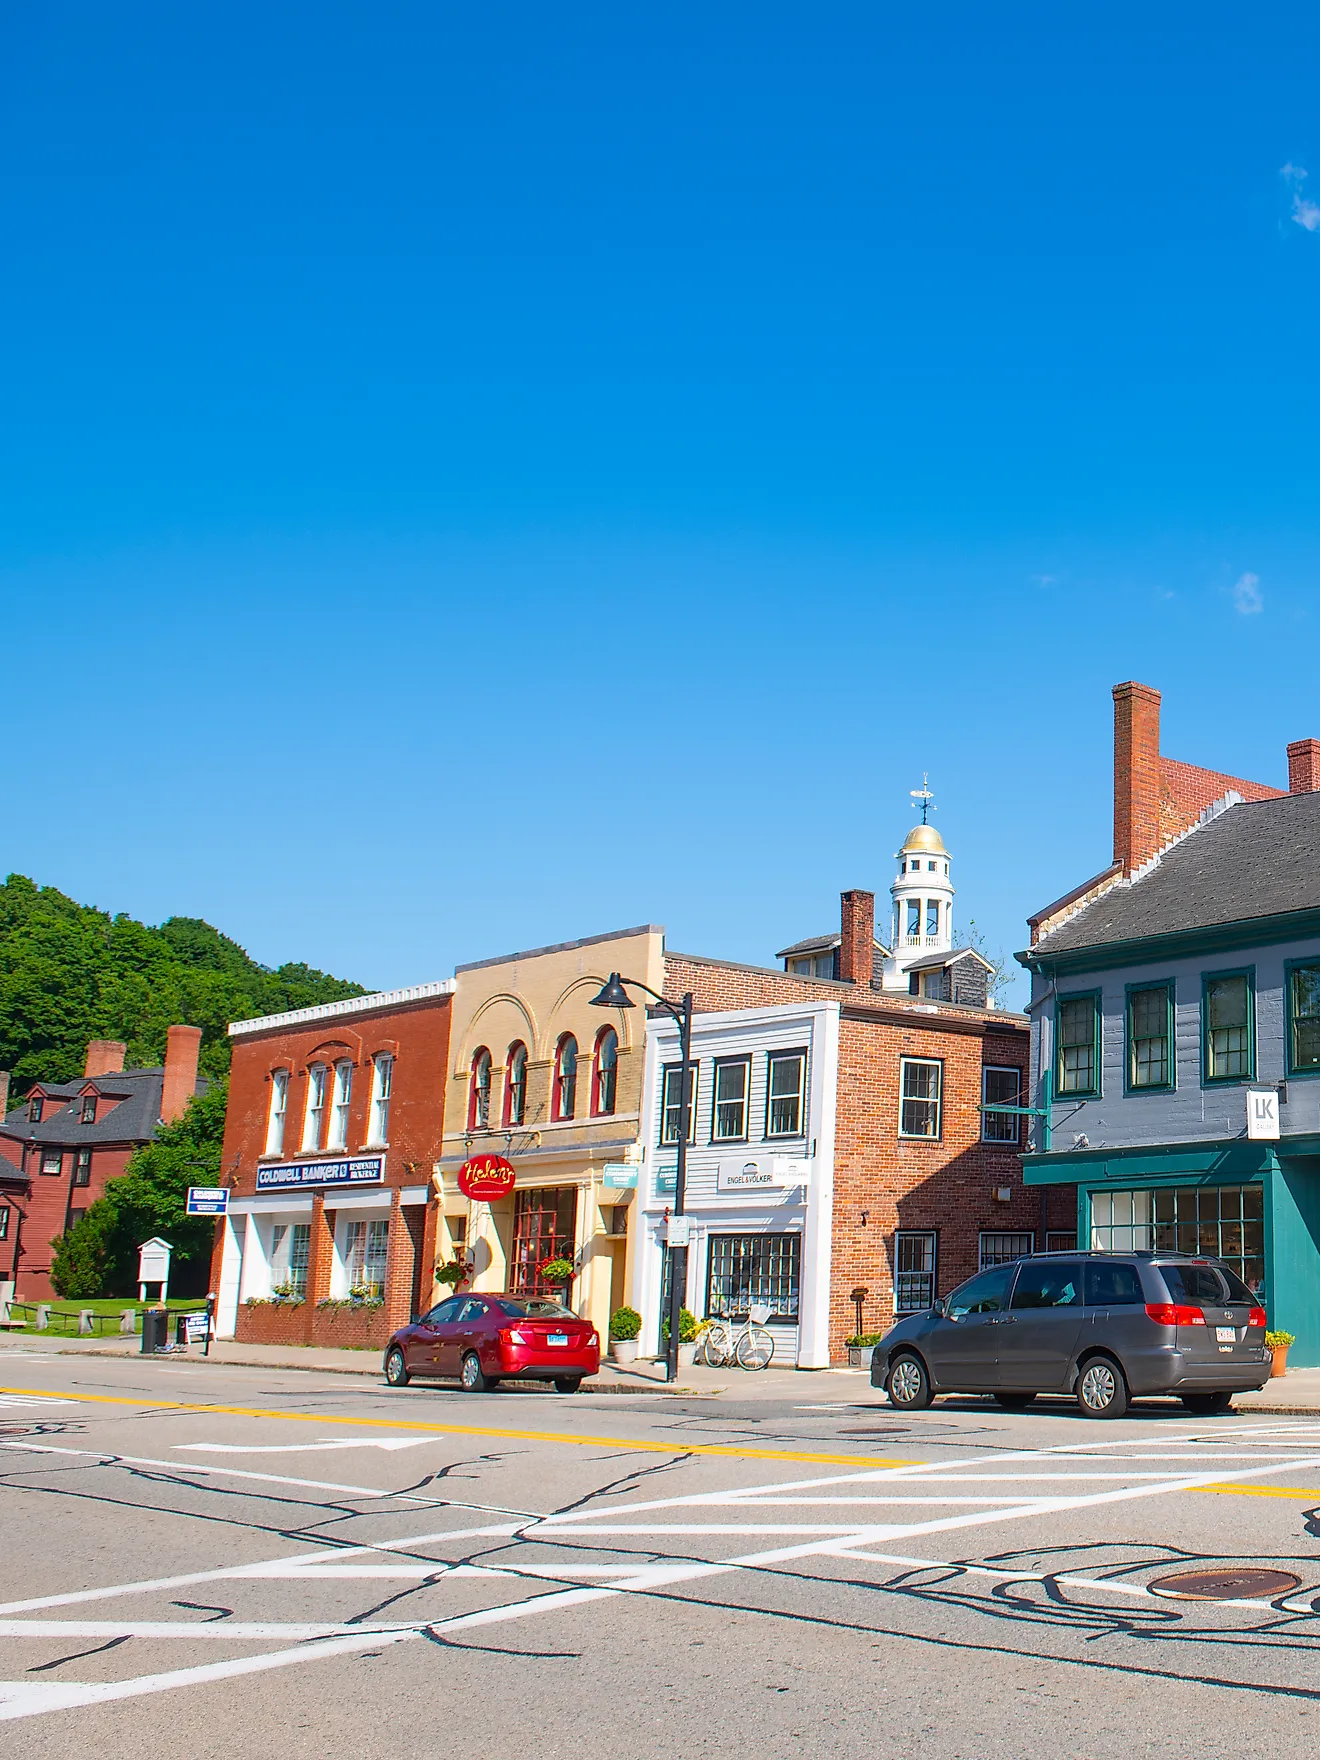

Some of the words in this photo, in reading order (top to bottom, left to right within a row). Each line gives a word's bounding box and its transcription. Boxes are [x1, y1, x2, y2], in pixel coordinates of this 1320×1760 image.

[1255, 1098, 1274, 1119] LK
[260, 1167, 301, 1184] COLDWELL
[302, 1164, 339, 1181] BANKER
